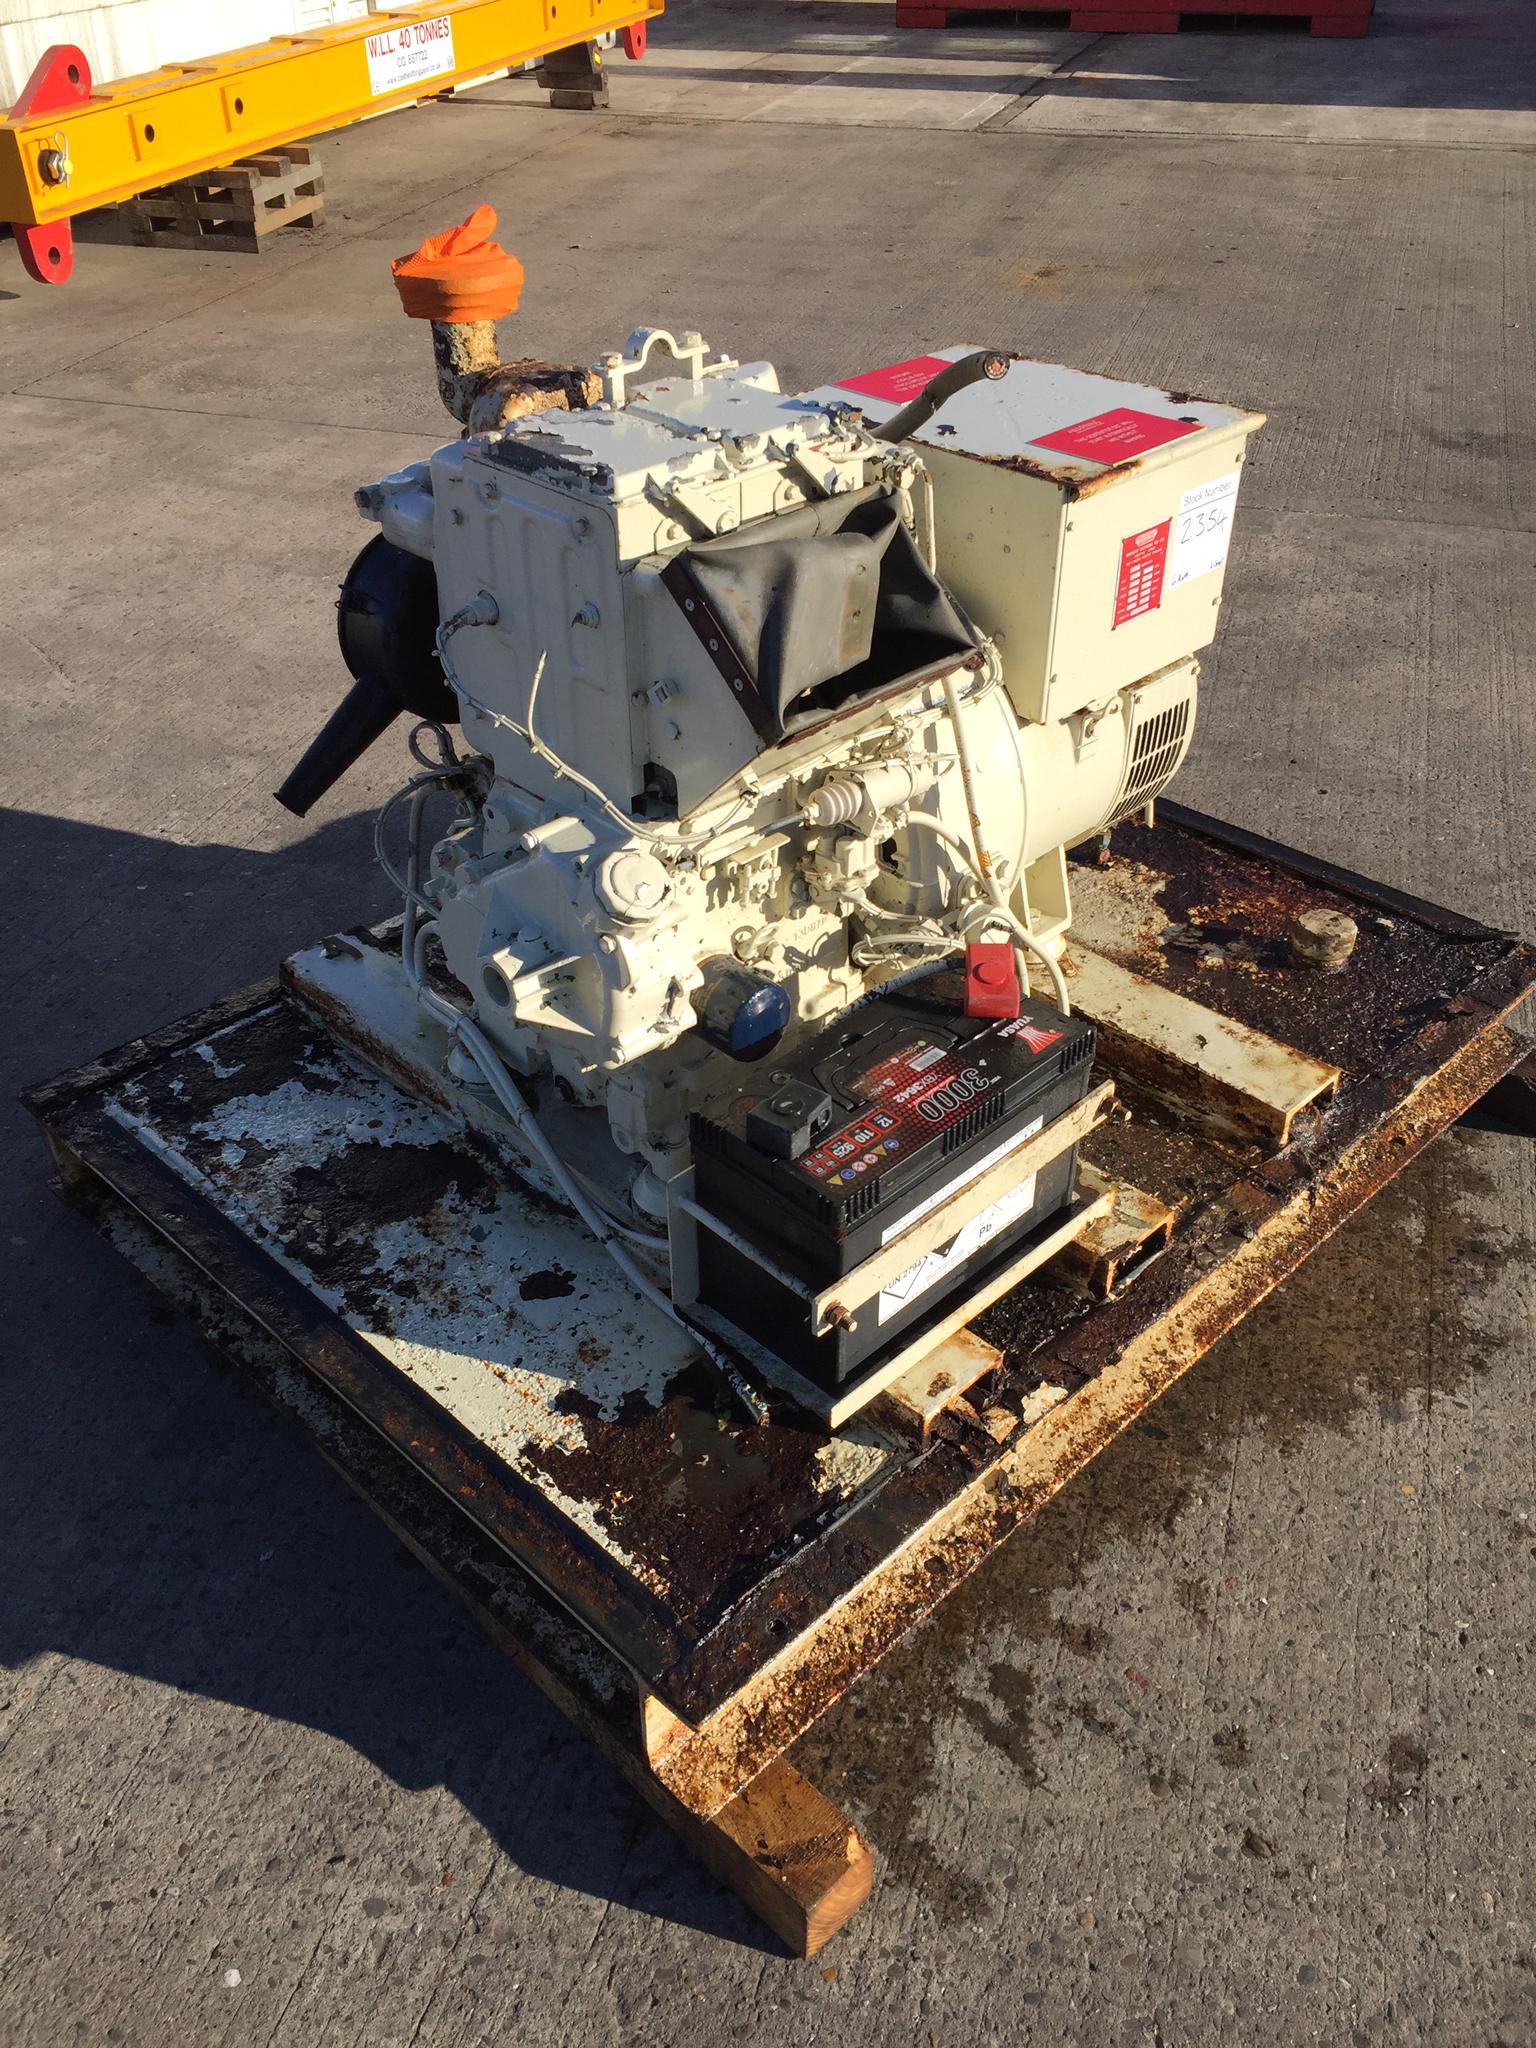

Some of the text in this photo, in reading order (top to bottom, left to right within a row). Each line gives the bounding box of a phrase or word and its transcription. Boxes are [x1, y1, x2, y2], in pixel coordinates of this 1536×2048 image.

[368, 17, 450, 58] W.L.L. 40 TONNES
[1205, 481, 1232, 497] Number
[997, 1015, 1034, 1038] YUASA
[893, 1072, 942, 1104] YBX3642
[916, 1068, 990, 1122] 3000
[876, 1116, 894, 1128] 12
[854, 1129, 875, 1143] 110
[833, 1142, 856, 1158] 925
[979, 1223, 993, 1238] Pb
